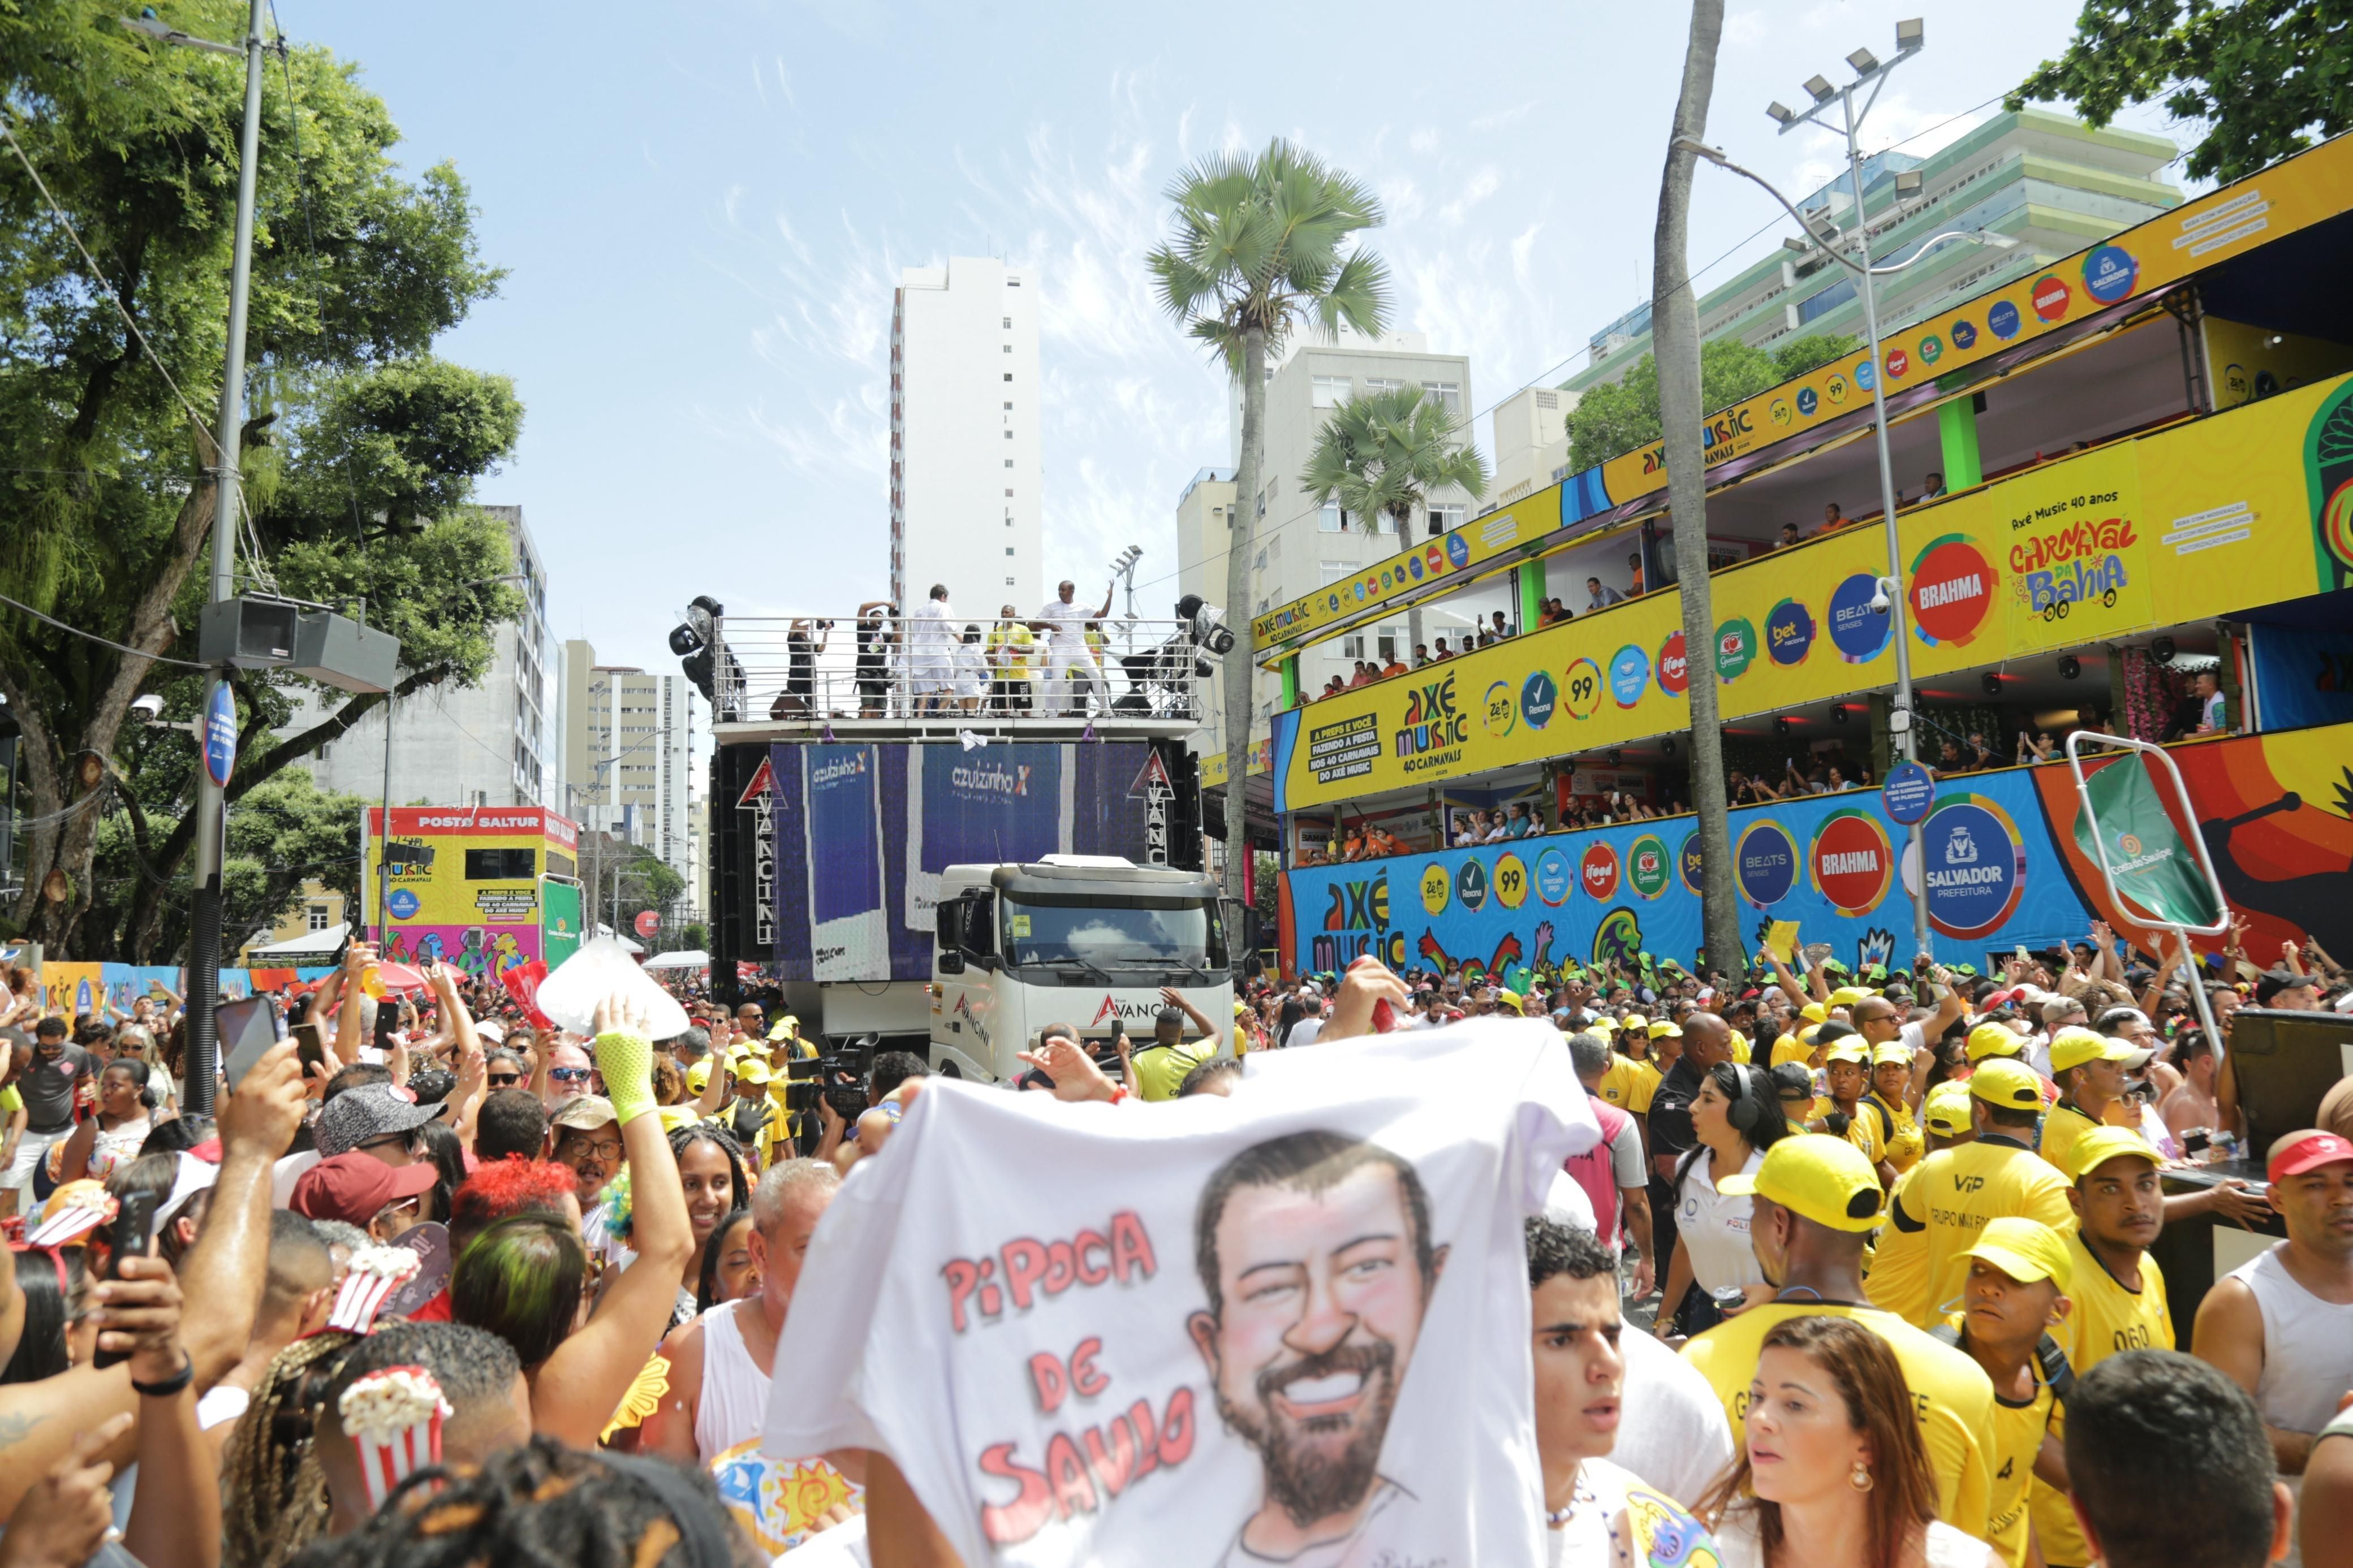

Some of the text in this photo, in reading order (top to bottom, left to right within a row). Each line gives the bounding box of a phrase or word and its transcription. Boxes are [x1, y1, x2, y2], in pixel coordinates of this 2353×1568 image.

[2093, 267, 2130, 288] SALVADOR
[2036, 289, 2066, 309] BRAHMA
[1830, 383, 1842, 396] 99
[2012, 491, 2118, 530] Axé Music 40 anos
[2054, 564, 2072, 579] DA
[1920, 573, 1982, 611] BRAHMA
[1836, 602, 1873, 622] BEAT
[1773, 621, 1796, 640] bet
[1837, 620, 1863, 632] SENSES
[1785, 636, 1806, 647] nacional
[1664, 655, 1687, 673] ifoo
[1571, 676, 1593, 702] 99
[1617, 676, 1640, 688] mercado
[1490, 702, 1500, 716] Zé
[1529, 703, 1551, 715] Rexona
[1315, 714, 1372, 741] A PREFS E VOCÊ
[1313, 731, 1375, 755] FAZENDO A FESTA
[1311, 745, 1378, 770] NOS 40 CARNAVAIS
[1403, 749, 1462, 774] 40 CARNAVAIS
[1320, 762, 1370, 782] DO AXÉ MUSIC
[419, 817, 539, 828] POSTO SALTUR
[546, 817, 575, 844] POSTO SALTUR
[1687, 852, 1701, 866] be
[1746, 854, 1787, 868] BEATS
[1822, 850, 1878, 875] BRAHMA
[1544, 876, 1564, 885] mercado
[1586, 862, 1613, 880] ifood
[1747, 869, 1769, 878] SENSES
[1927, 866, 2003, 887] SALVADOR
[1427, 881, 1436, 894] Zé
[1501, 870, 1520, 892] 99
[1548, 884, 1560, 893] pago
[1462, 889, 1482, 898] Rexona
[1938, 886, 1992, 898] PREFEITURA
[954, 991, 989, 1046] AVANCINI
[1028, 1337, 1111, 1415] DE
[979, 1385, 1195, 1545] SAULO
